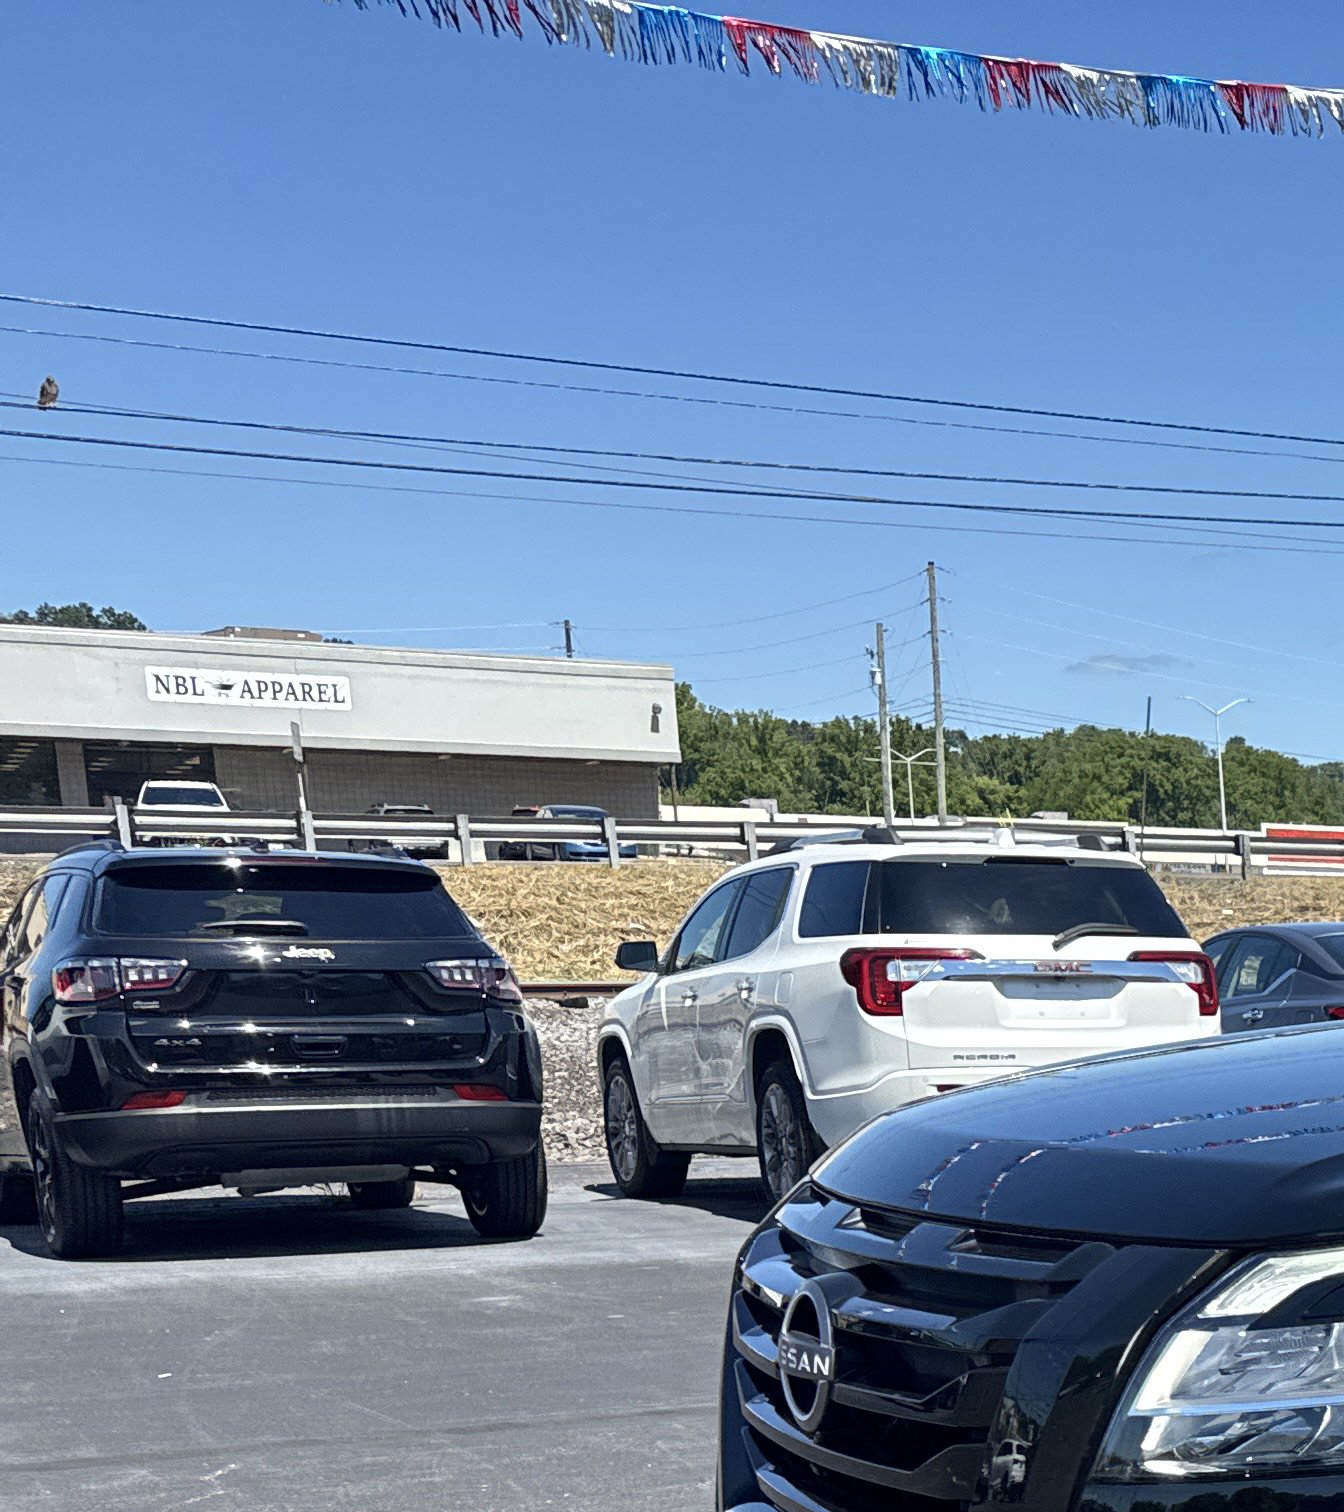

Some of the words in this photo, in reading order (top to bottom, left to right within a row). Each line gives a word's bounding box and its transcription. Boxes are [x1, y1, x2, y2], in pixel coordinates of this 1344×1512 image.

[152, 673, 206, 697] NBL
[239, 679, 346, 704] APPAREL
[281, 944, 336, 964] Jeep
[1033, 961, 1093, 975] GMC
